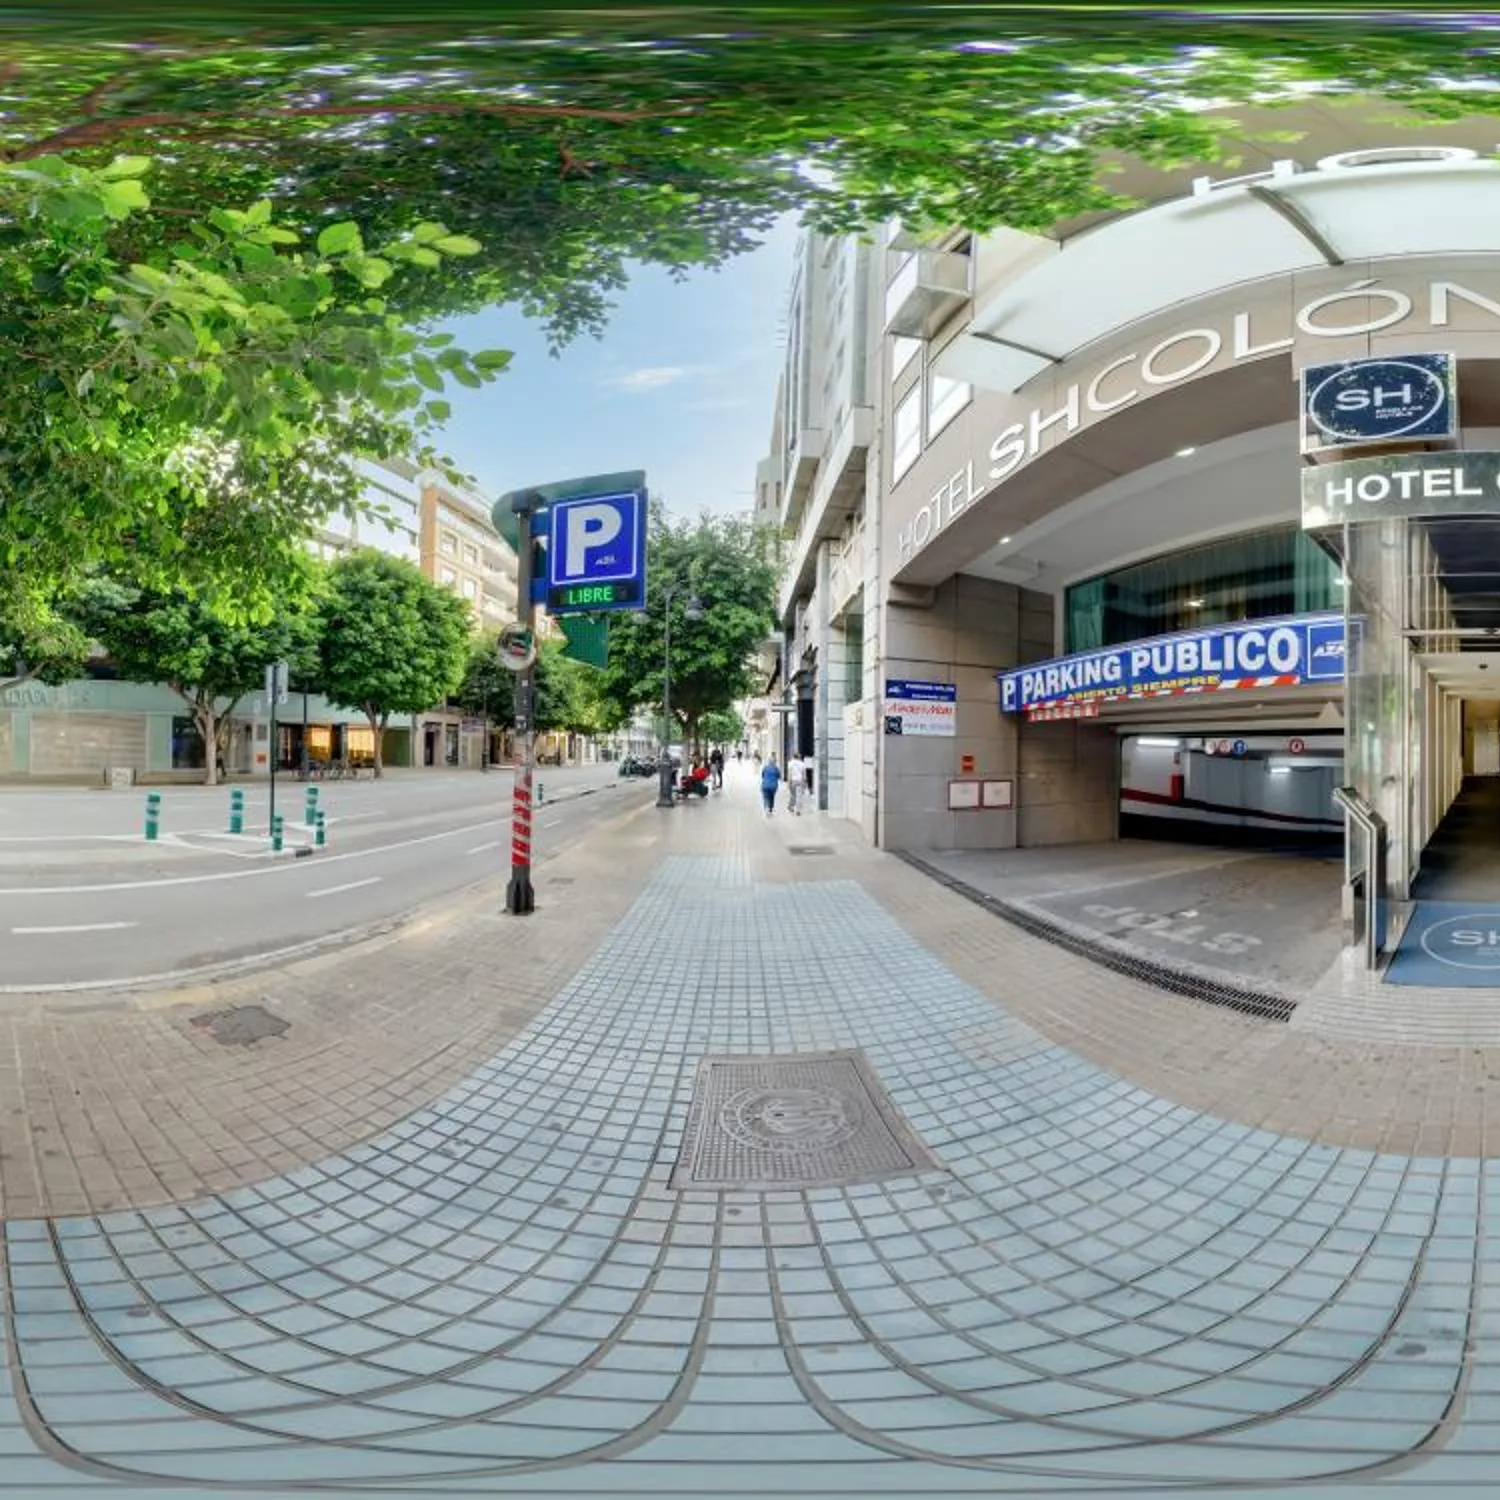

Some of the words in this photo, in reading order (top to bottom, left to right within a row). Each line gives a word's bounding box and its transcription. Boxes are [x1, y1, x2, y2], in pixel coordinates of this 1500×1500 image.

[1335, 383, 1412, 411] SH
[1325, 467, 1483, 507] HOTEL
[897, 459, 986, 562] HOTEL
[565, 503, 623, 577] P
[568, 586, 613, 605] LIBRE
[1020, 655, 1122, 704] PARKING
[1130, 627, 1301, 678] PUBLICO
[1131, 675, 1220, 693] SIEMPRE
